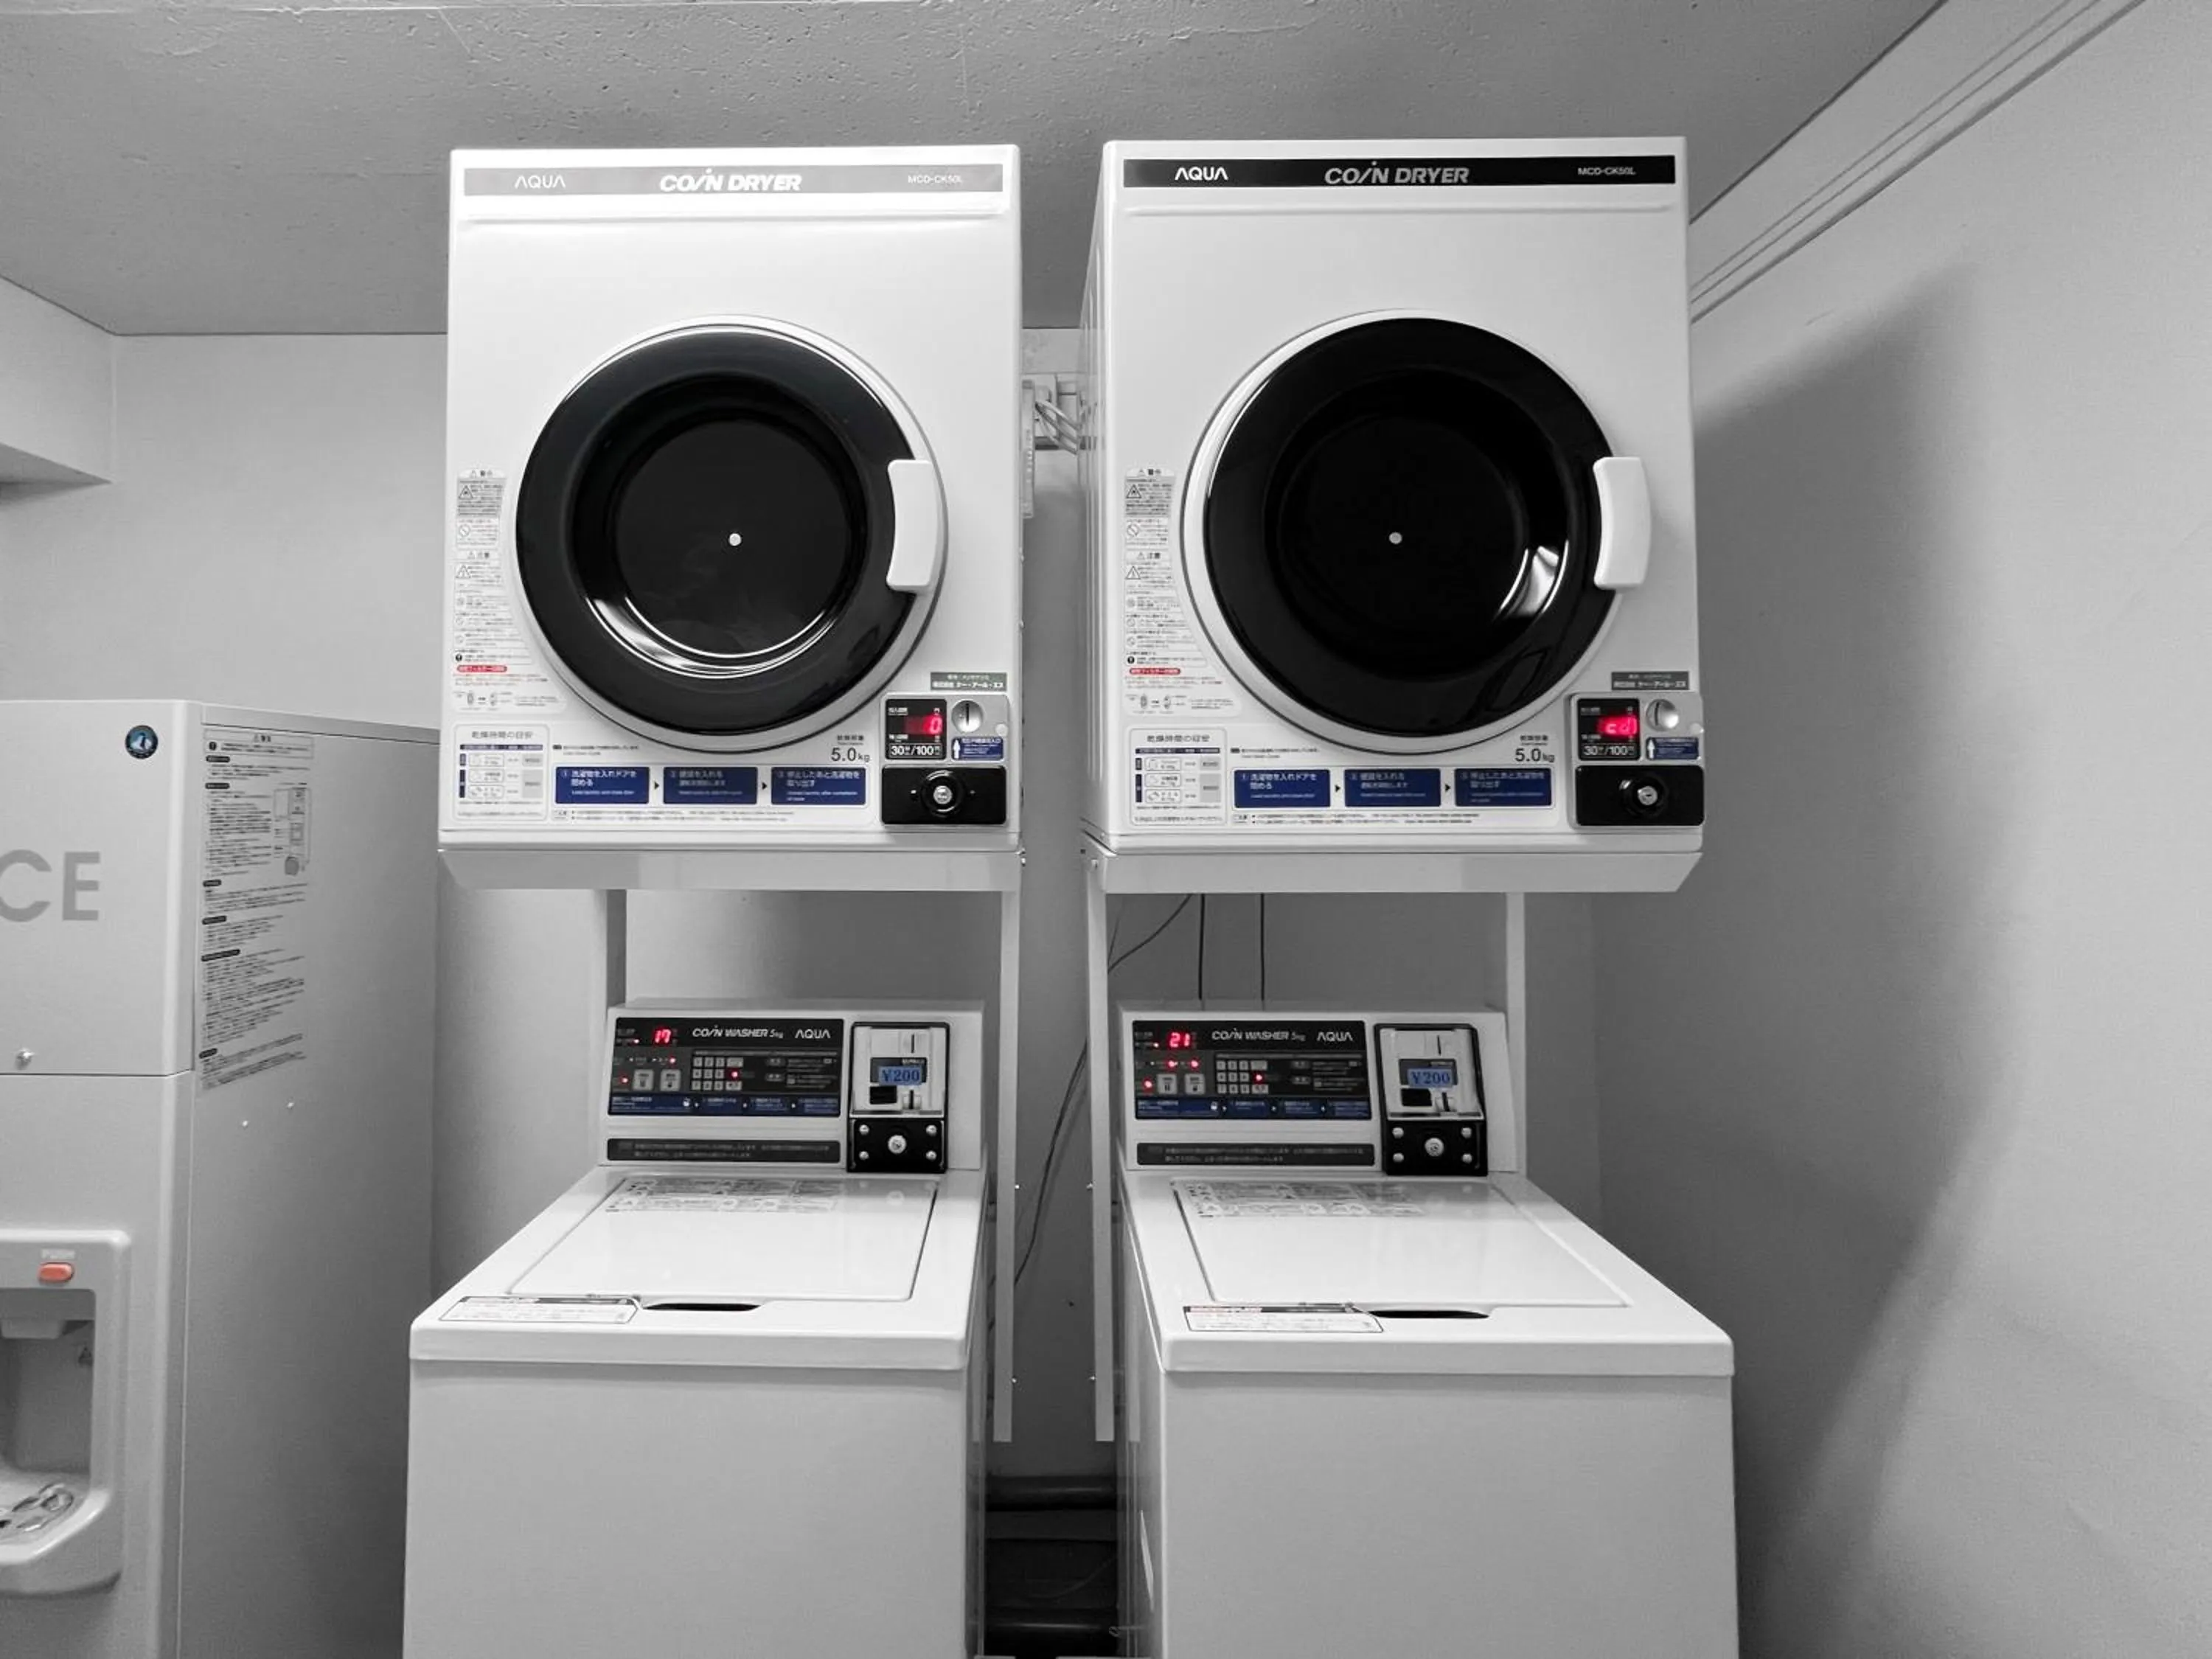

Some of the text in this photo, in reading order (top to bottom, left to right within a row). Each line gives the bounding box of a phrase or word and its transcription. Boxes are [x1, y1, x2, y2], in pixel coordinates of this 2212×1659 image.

[659, 167, 802, 192] COIN DRYER
[1175, 167, 1228, 181] AQUA
[1324, 161, 1470, 184] COIN DRYER
[515, 174, 566, 189] AQUA
[929, 715, 943, 734] 0
[655, 1029, 672, 1043] 17
[692, 1024, 723, 1038] COIN
[725, 1029, 768, 1038] WASHER
[795, 1029, 831, 1039] AQUA
[1211, 1027, 1242, 1041] COIN
[1245, 1031, 1290, 1040] WASHER
[1317, 1032, 1353, 1042] AQUA
[1169, 1032, 1192, 1048] 21
[882, 1068, 919, 1082] ¥200
[1411, 1071, 1450, 1085] ¥200
